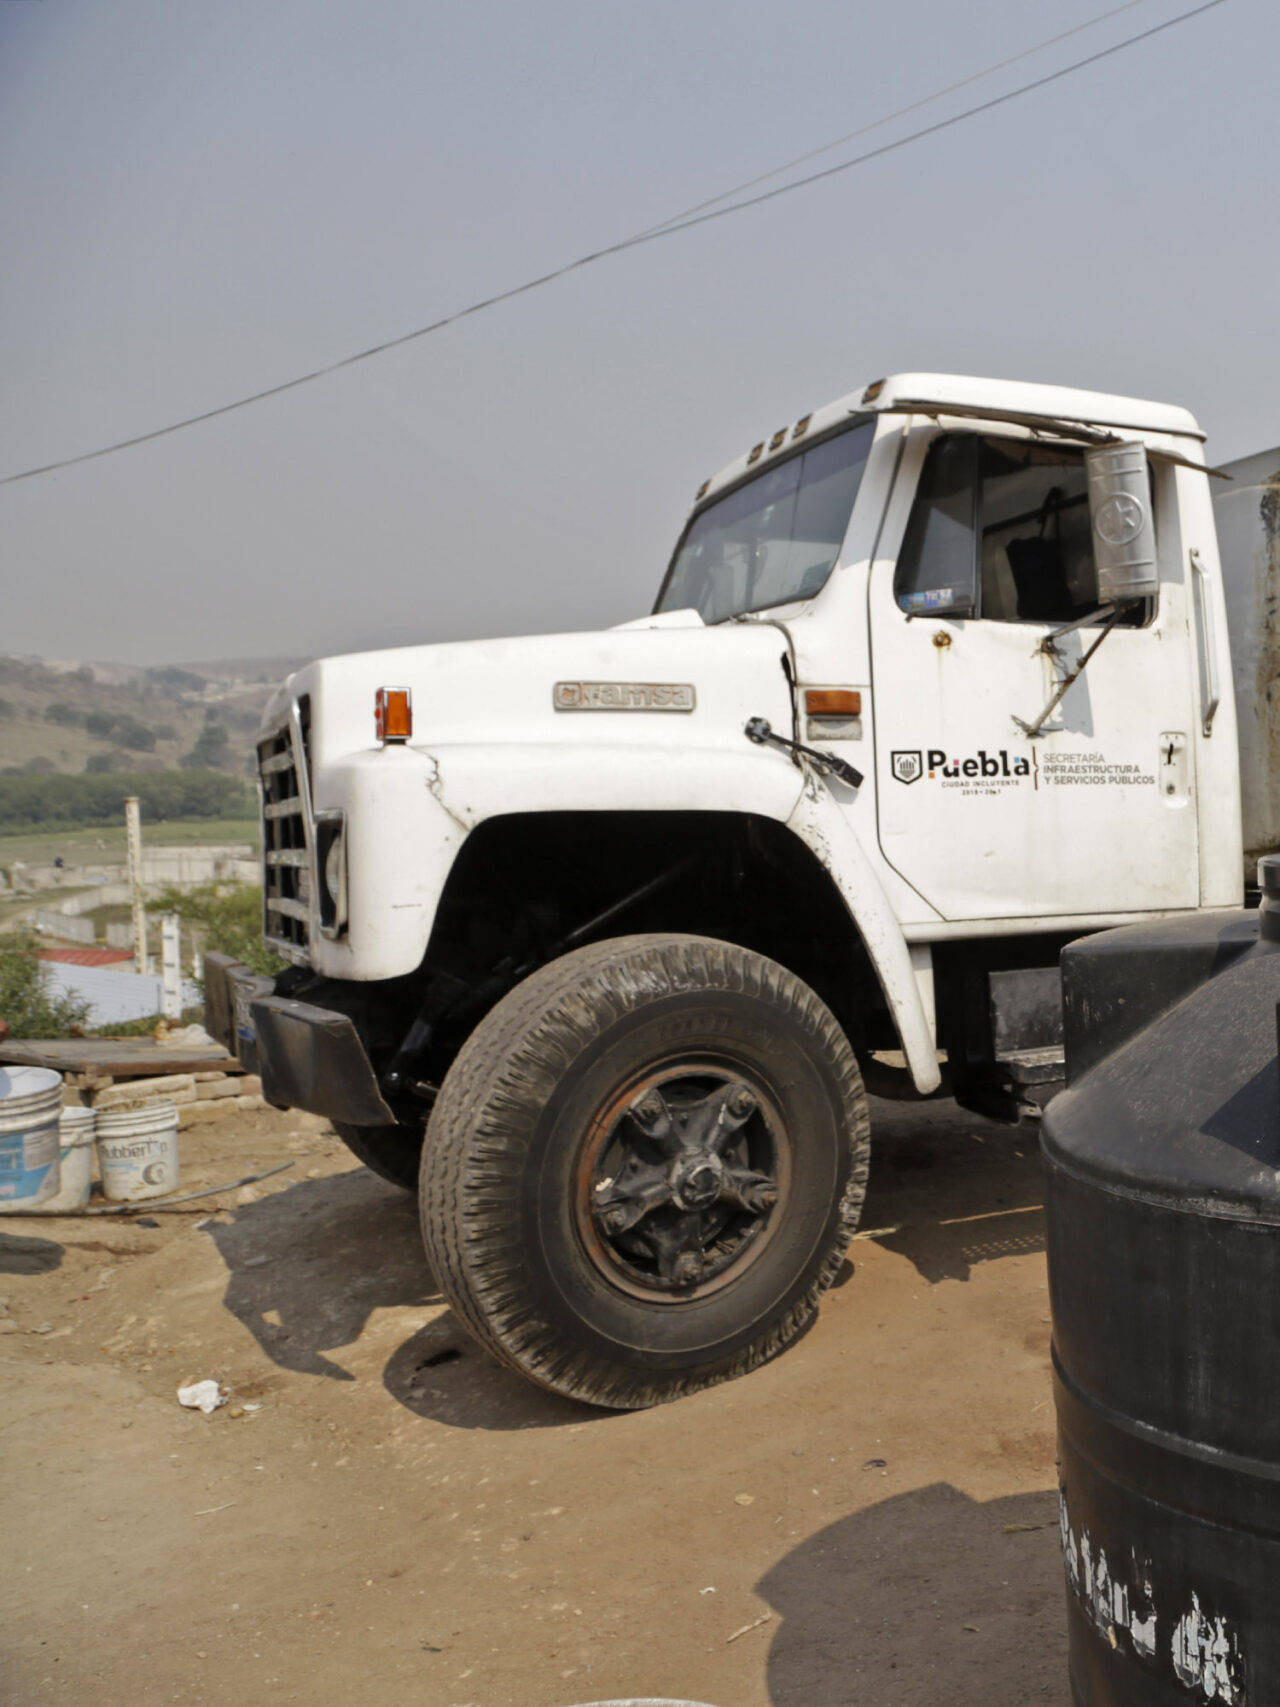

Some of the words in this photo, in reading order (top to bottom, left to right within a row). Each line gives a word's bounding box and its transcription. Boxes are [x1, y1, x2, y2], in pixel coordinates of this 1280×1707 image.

[1043, 752, 1105, 764] SECRETARÍA
[926, 749, 1031, 779] Puebla
[1043, 764, 1141, 774] INFRAESTRUCTURA
[1044, 775, 1051, 785] Y
[1053, 775, 1106, 785] SERVICIOS
